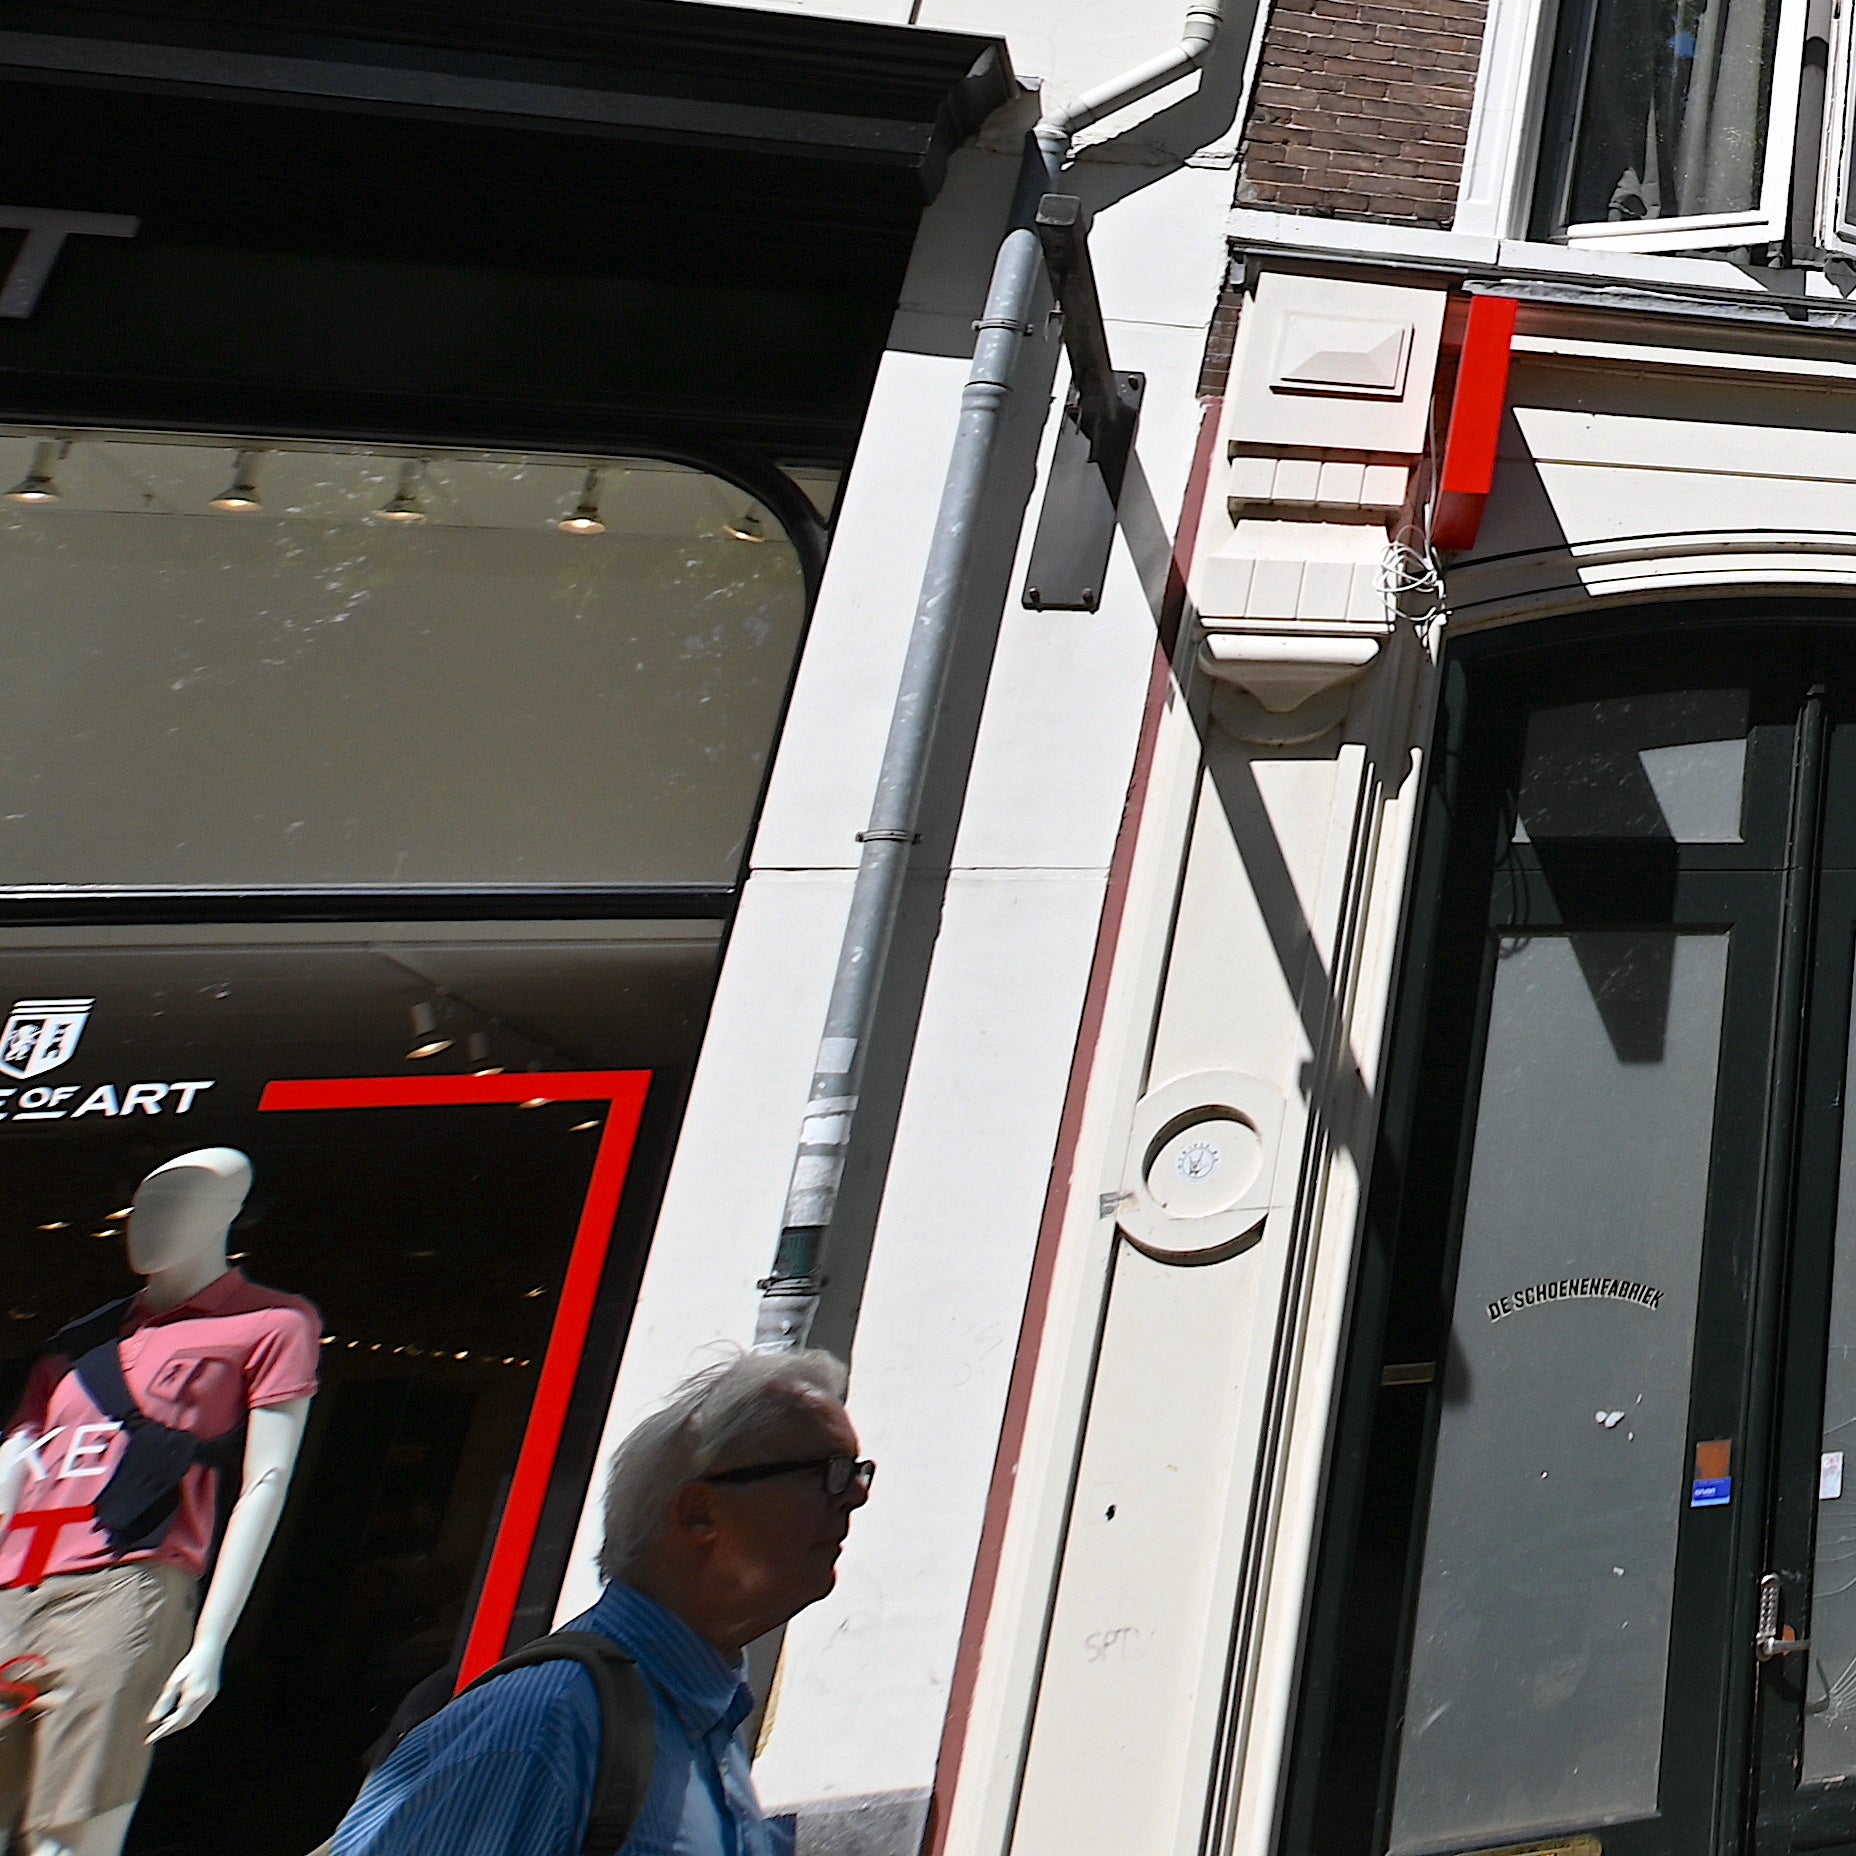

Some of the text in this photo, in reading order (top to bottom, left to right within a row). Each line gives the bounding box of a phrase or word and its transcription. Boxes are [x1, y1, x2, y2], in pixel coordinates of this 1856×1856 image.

[17, 1085, 82, 1110] OF
[69, 1080, 217, 1119] ART
[1486, 1277, 1665, 1324] DE SCHOENENFABRIEK
